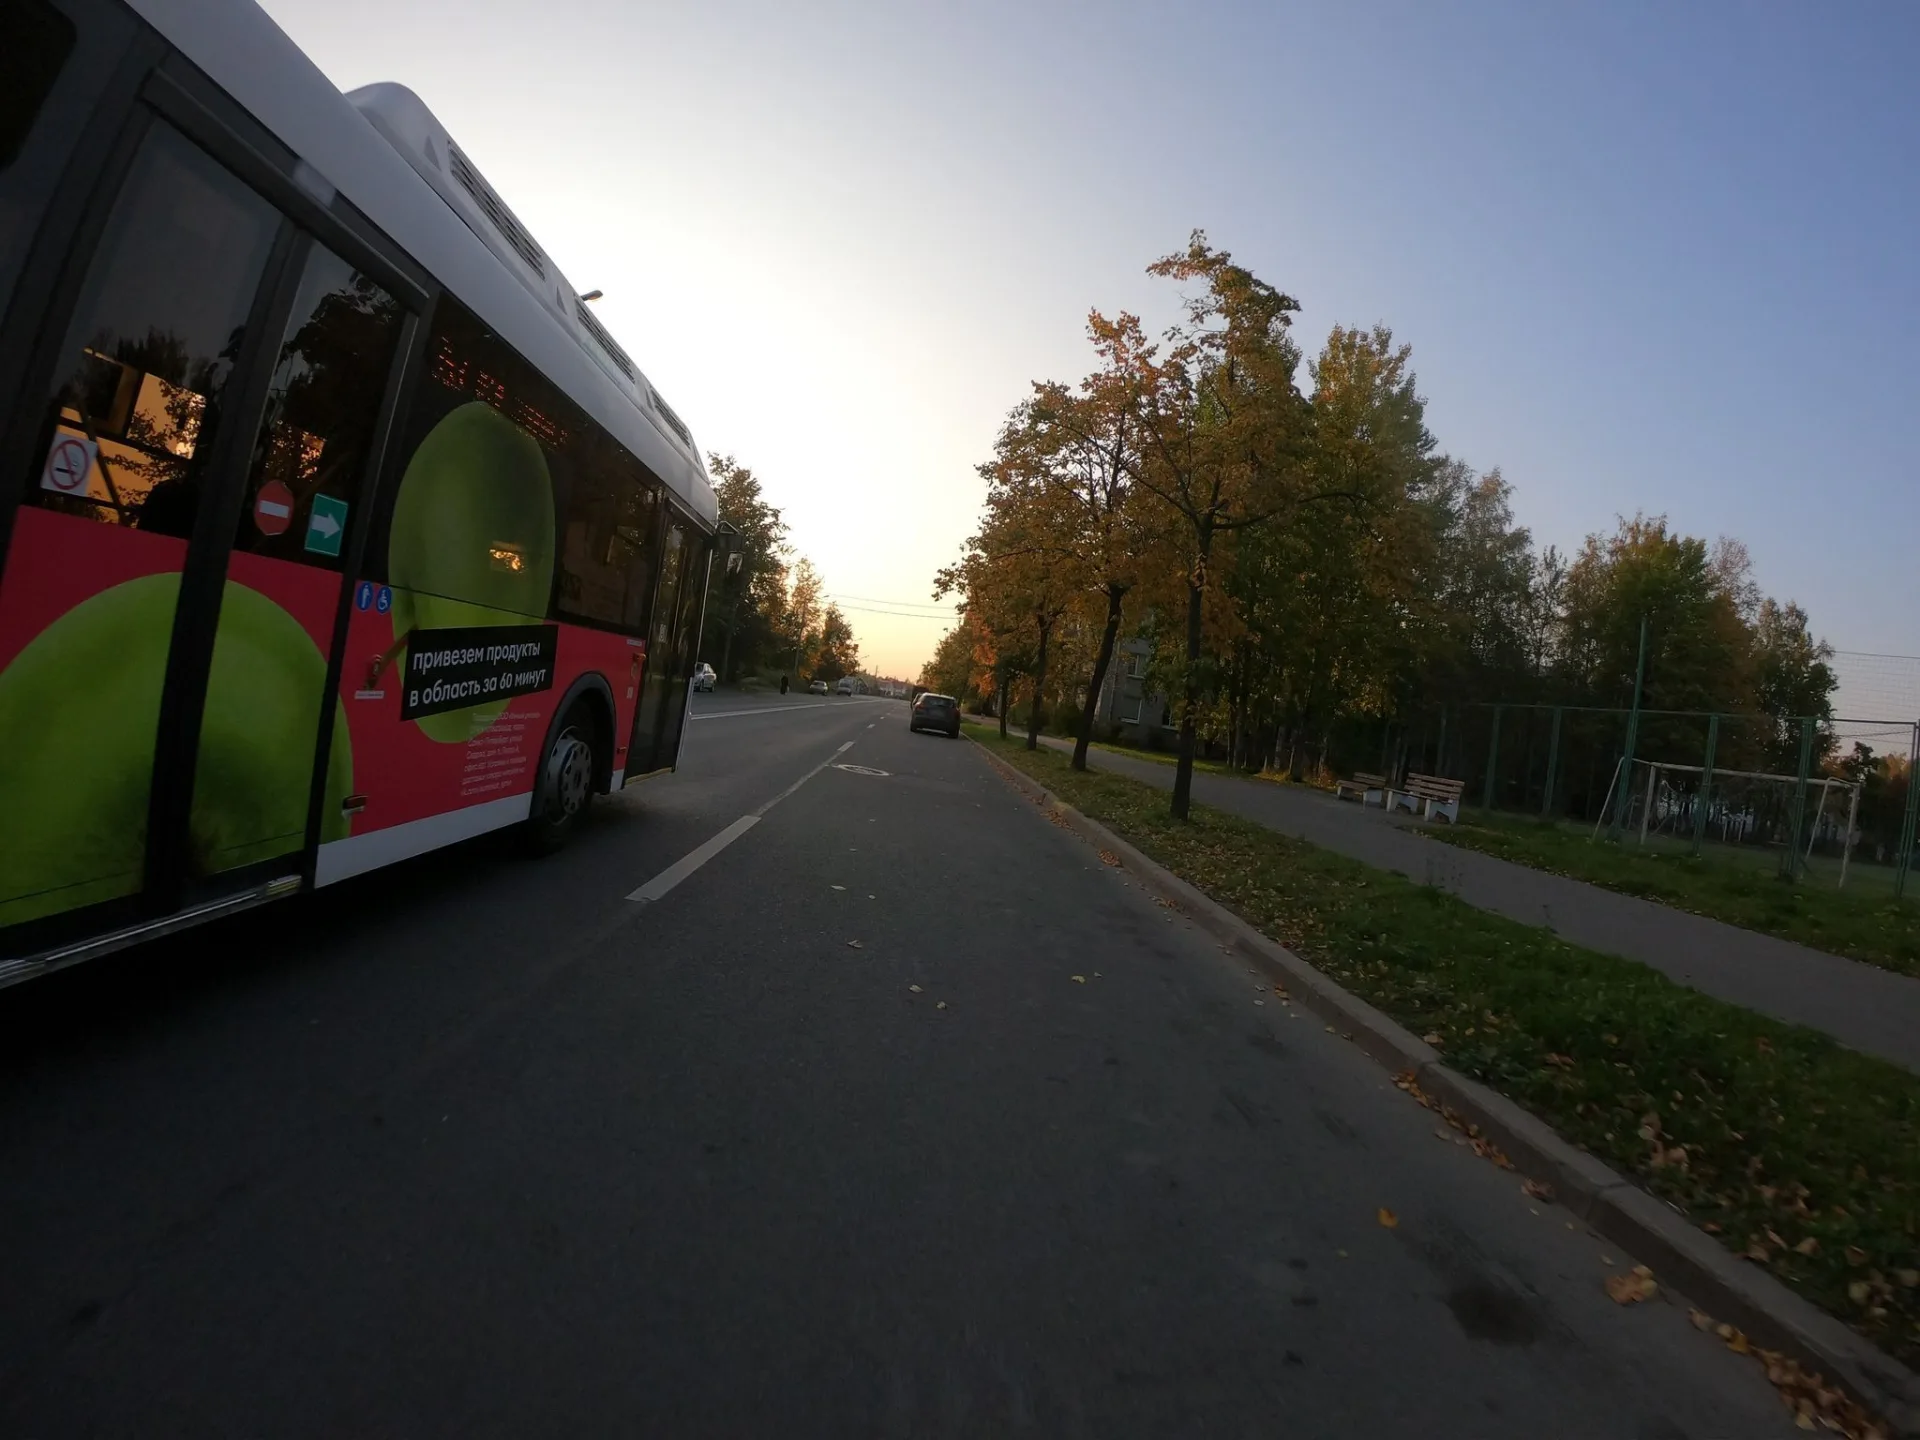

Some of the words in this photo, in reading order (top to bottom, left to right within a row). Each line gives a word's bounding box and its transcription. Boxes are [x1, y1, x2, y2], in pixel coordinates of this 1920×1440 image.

[413, 648, 484, 675] привезем
[487, 641, 541, 665] продукты
[409, 690, 419, 707] в
[423, 679, 481, 705] область
[483, 678, 497, 693] за
[500, 673, 513, 689] 60
[514, 669, 546, 687] минут
